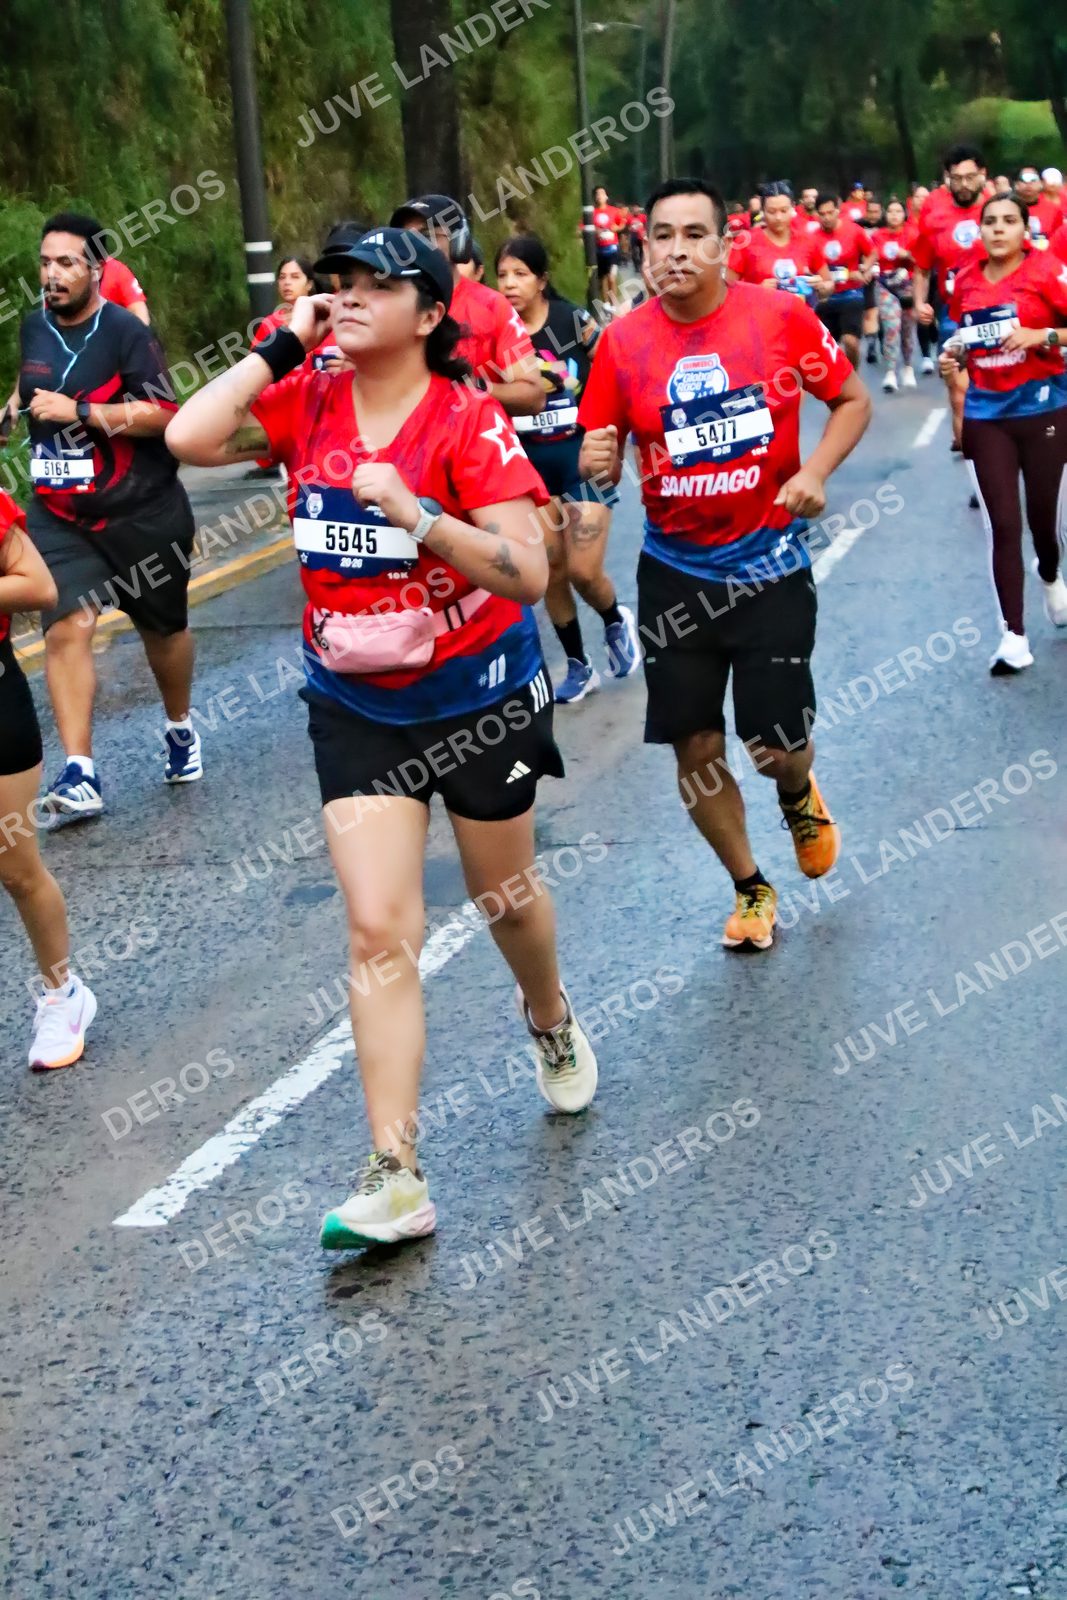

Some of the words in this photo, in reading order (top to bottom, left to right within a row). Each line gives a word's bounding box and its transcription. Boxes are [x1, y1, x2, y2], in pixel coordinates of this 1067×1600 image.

[977, 323, 1001, 339] 4507
[682, 360, 714, 370] BIMBO
[682, 371, 713, 383] Global
[676, 382, 702, 392] Race
[695, 420, 737, 447] 5477
[44, 461, 70, 476] 5164
[660, 465, 761, 497] SANTIAGO
[325, 524, 377, 554] 5545
[387, 571, 409, 580] 10K
